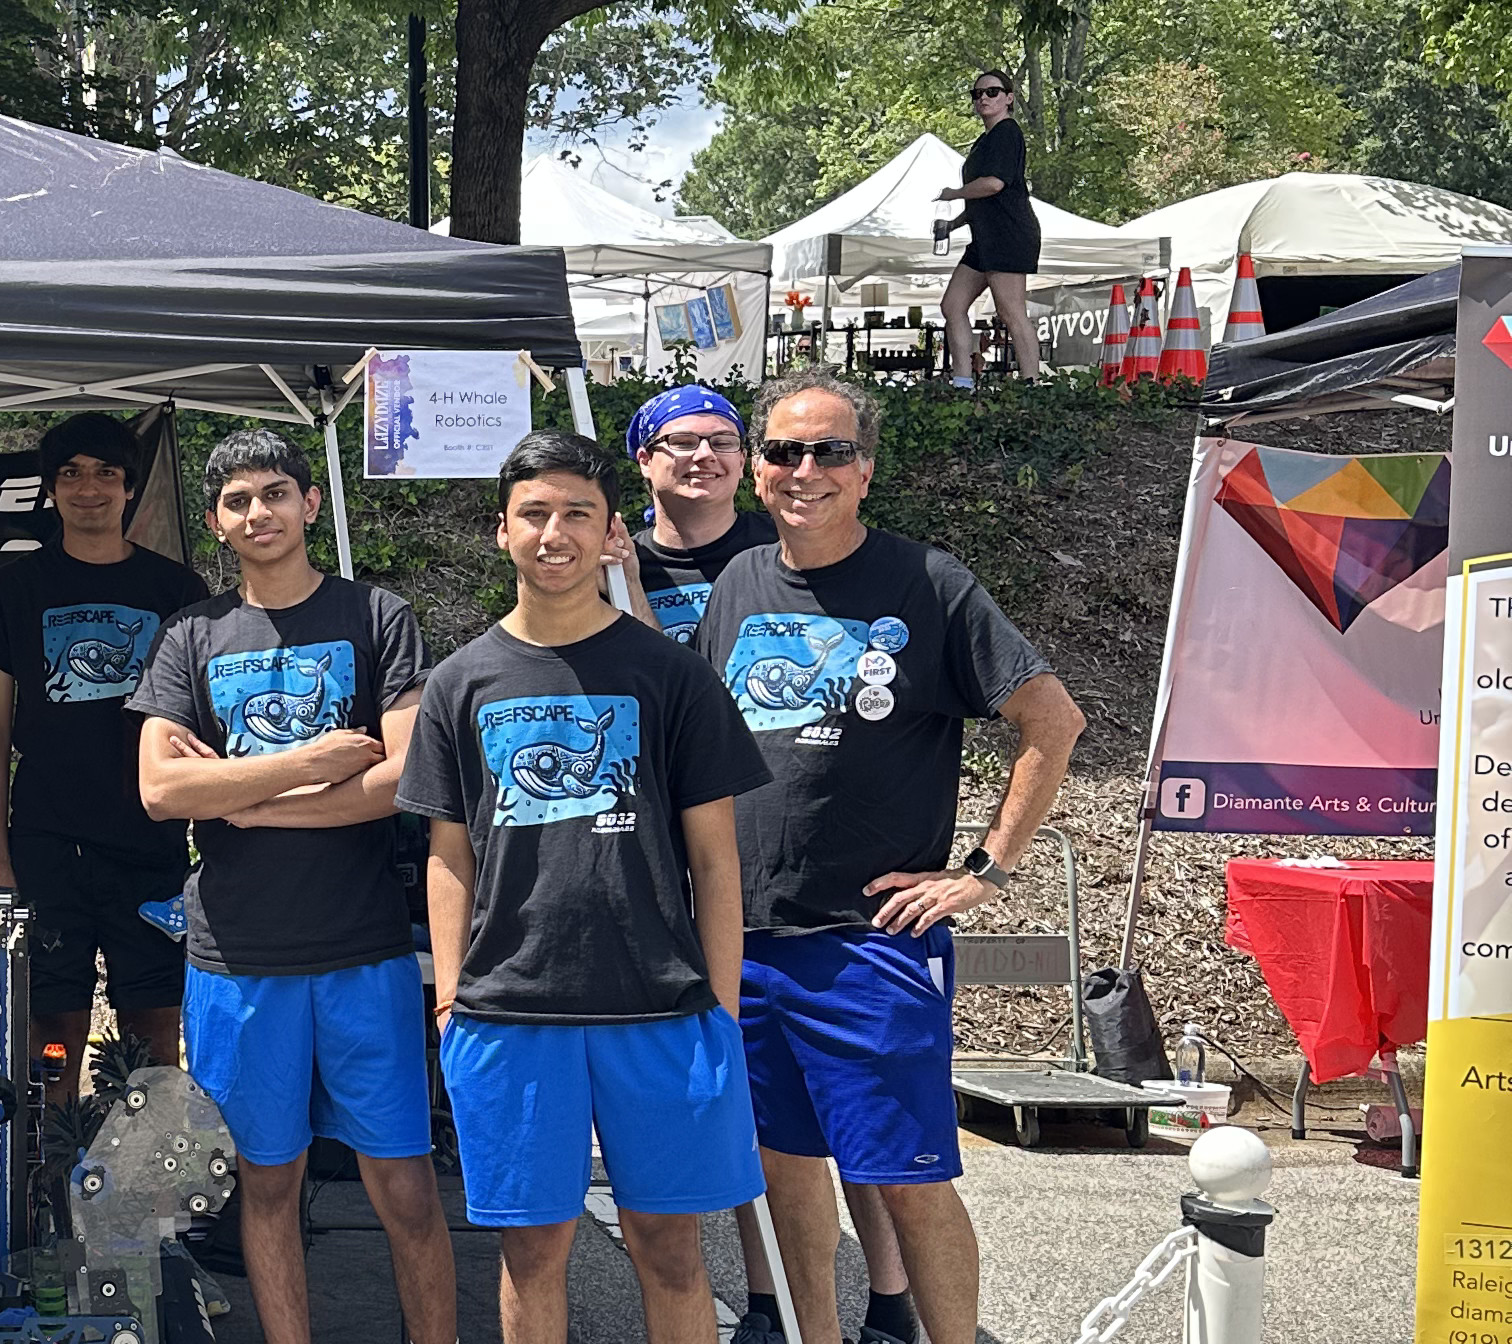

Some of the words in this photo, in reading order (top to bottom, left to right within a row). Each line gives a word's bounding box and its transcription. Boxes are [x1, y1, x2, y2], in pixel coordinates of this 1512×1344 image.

[428, 391, 454, 405] 4-H
[458, 391, 508, 405] Whale
[435, 413, 502, 428] Robotics
[48, 609, 116, 628] REEFSCAPE
[214, 654, 297, 679] REEFSCAPE
[863, 666, 892, 677] FIRST
[484, 705, 576, 729] REEFSCAPE
[1213, 793, 1304, 811] Diamante
[1308, 795, 1350, 812] Arts
[1355, 796, 1372, 813] &
[1377, 796, 1437, 814] Cultur
